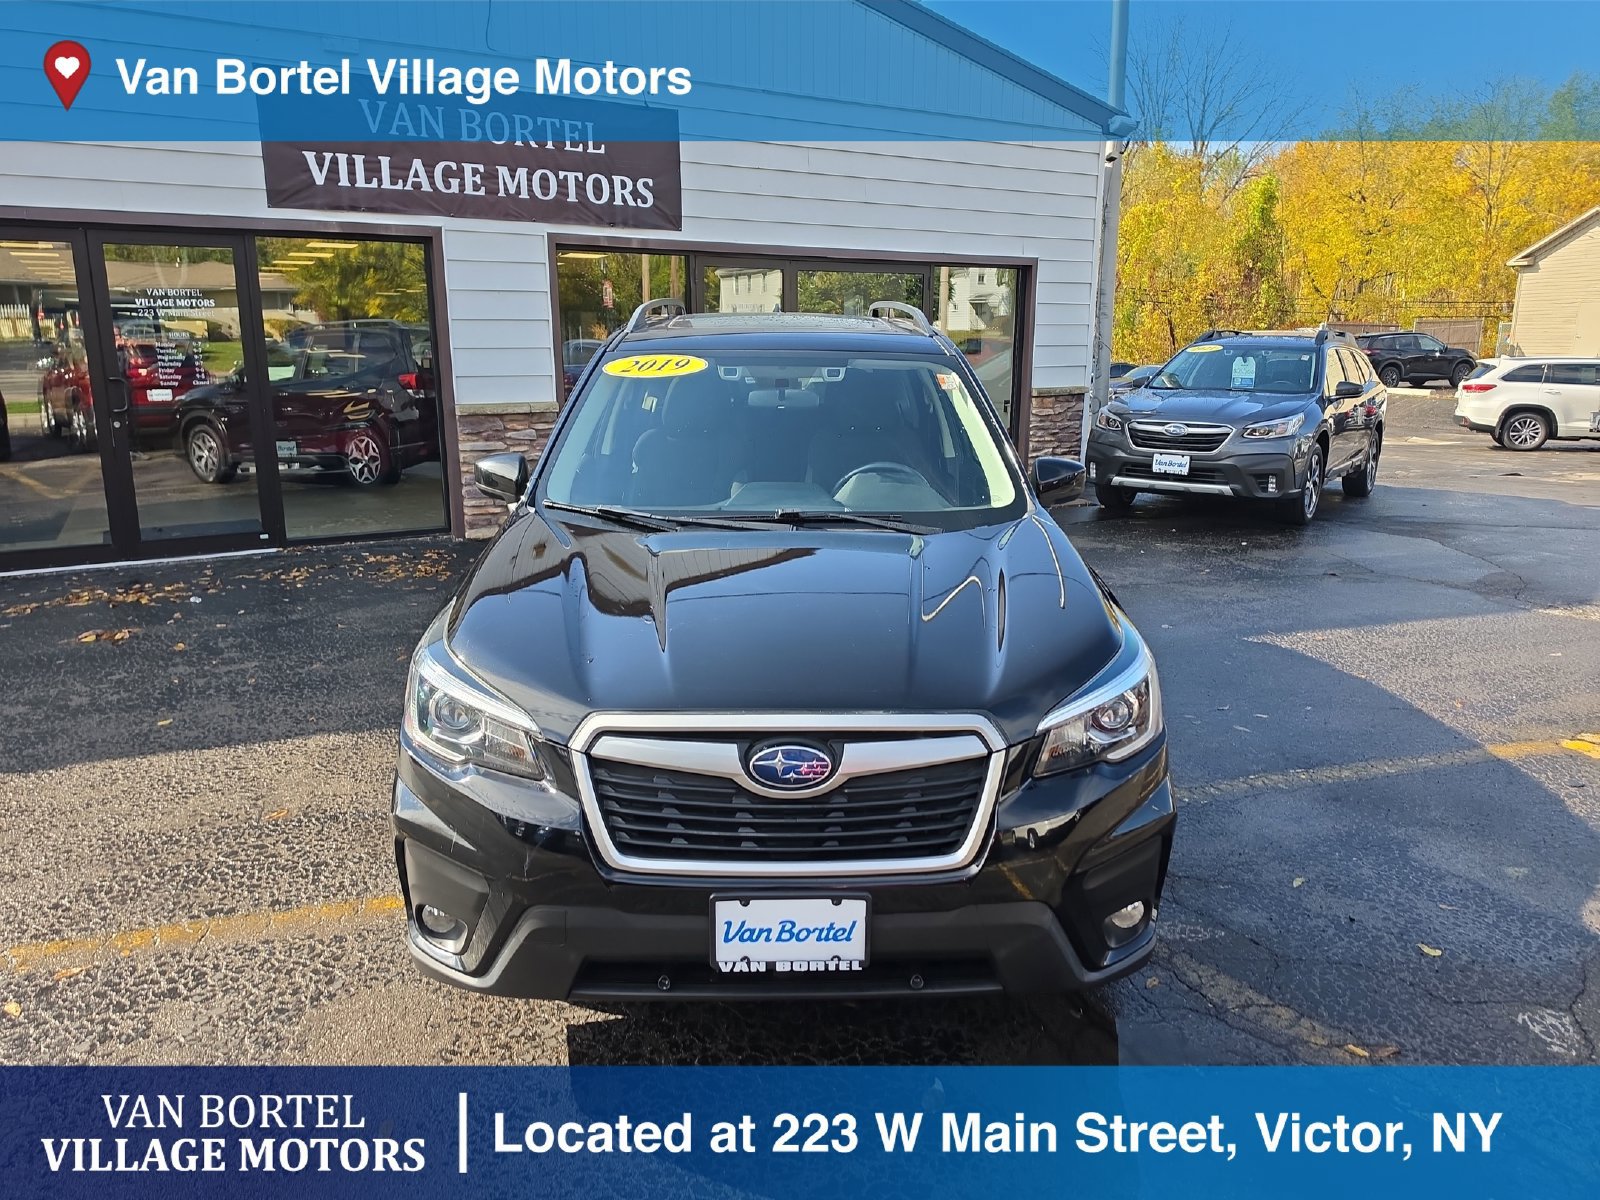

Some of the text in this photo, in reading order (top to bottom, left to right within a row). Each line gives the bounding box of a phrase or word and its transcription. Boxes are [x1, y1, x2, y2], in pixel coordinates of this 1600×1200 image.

[358, 99, 606, 154] VAN BORTEL
[302, 150, 655, 208] VILLAGE MOTORS
[146, 288, 203, 296] VAN BORTEL
[135, 298, 215, 307] VILLAGE MOTORS
[137, 309, 155, 317] 223
[620, 358, 691, 373] 2019
[723, 920, 857, 944] Van Bortel
[717, 960, 863, 973] VAN BORTEL
